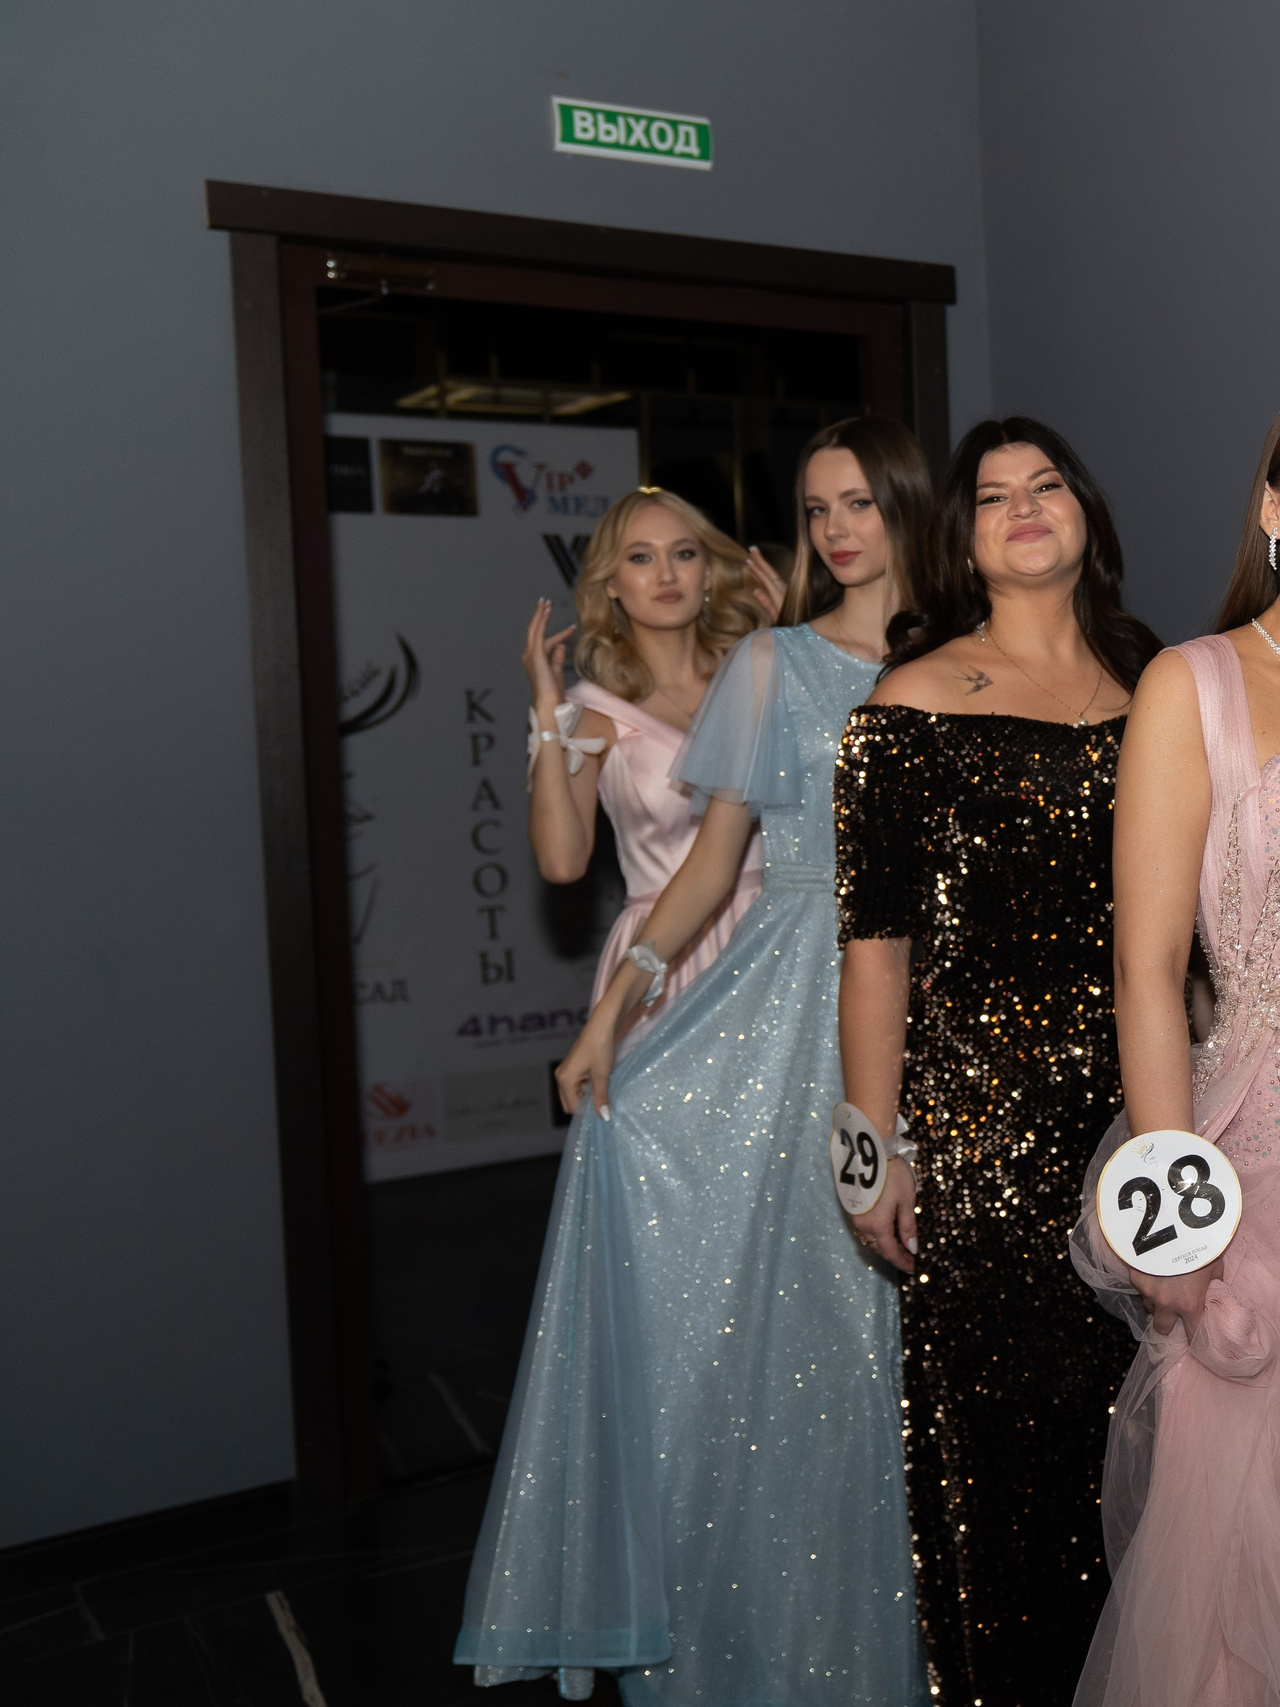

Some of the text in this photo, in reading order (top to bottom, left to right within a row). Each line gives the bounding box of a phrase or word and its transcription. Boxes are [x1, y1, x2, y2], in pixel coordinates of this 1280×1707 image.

[571, 108, 701, 157] ВЫХОД
[464, 687, 516, 986] КРАСОТЫ
[840, 1128, 879, 1190] 29
[1117, 1154, 1226, 1257] 28
[1184, 1254, 1199, 1264] 2024
